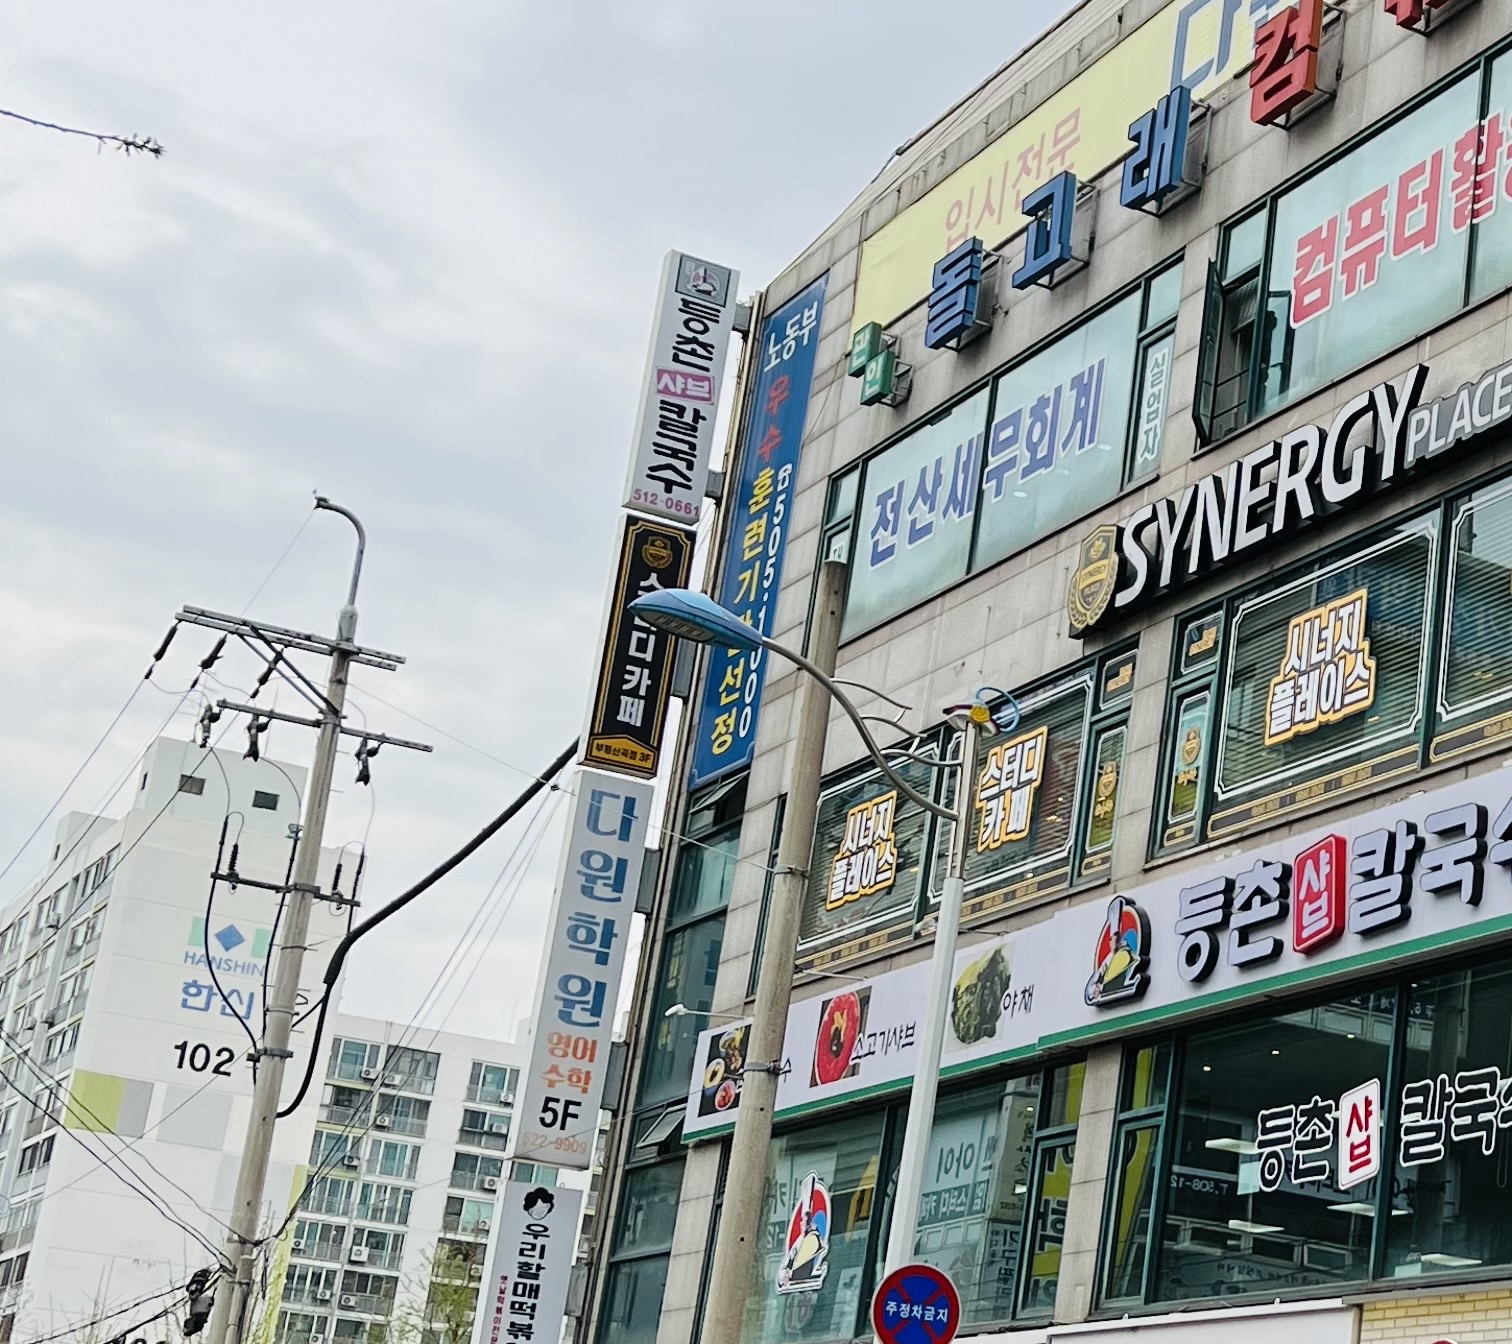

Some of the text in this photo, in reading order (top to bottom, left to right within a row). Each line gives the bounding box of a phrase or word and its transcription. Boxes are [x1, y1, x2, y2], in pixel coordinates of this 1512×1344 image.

[924, 85, 1192, 350] 돌고래
[764, 301, 818, 373] 노동부
[657, 371, 712, 399] 샤브
[1140, 348, 1170, 463] 실업자
[869, 356, 1106, 572] 전산세무회계
[1113, 364, 1428, 609] SYNERGY
[633, 488, 699, 518] 512-0661
[616, 572, 664, 727] 스디카페
[1287, 595, 1362, 674] 시너지
[1268, 663, 1374, 742] 플레이스
[831, 846, 896, 904] 플레이스
[555, 788, 639, 1028] 다원학원
[1174, 859, 1292, 982] 등촌
[183, 949, 266, 978] HANSHIN
[180, 978, 255, 1021] 한신
[1002, 984, 1034, 1021] 야채
[173, 1039, 235, 1077] 102
[547, 1032, 598, 1064] 영어
[850, 1021, 917, 1064] 소고기샤브
[541, 1063, 592, 1095] 수학
[540, 1096, 582, 1132] 5F
[1256, 1095, 1338, 1193] 등촌
[885, 1300, 949, 1324] 주정차금지
